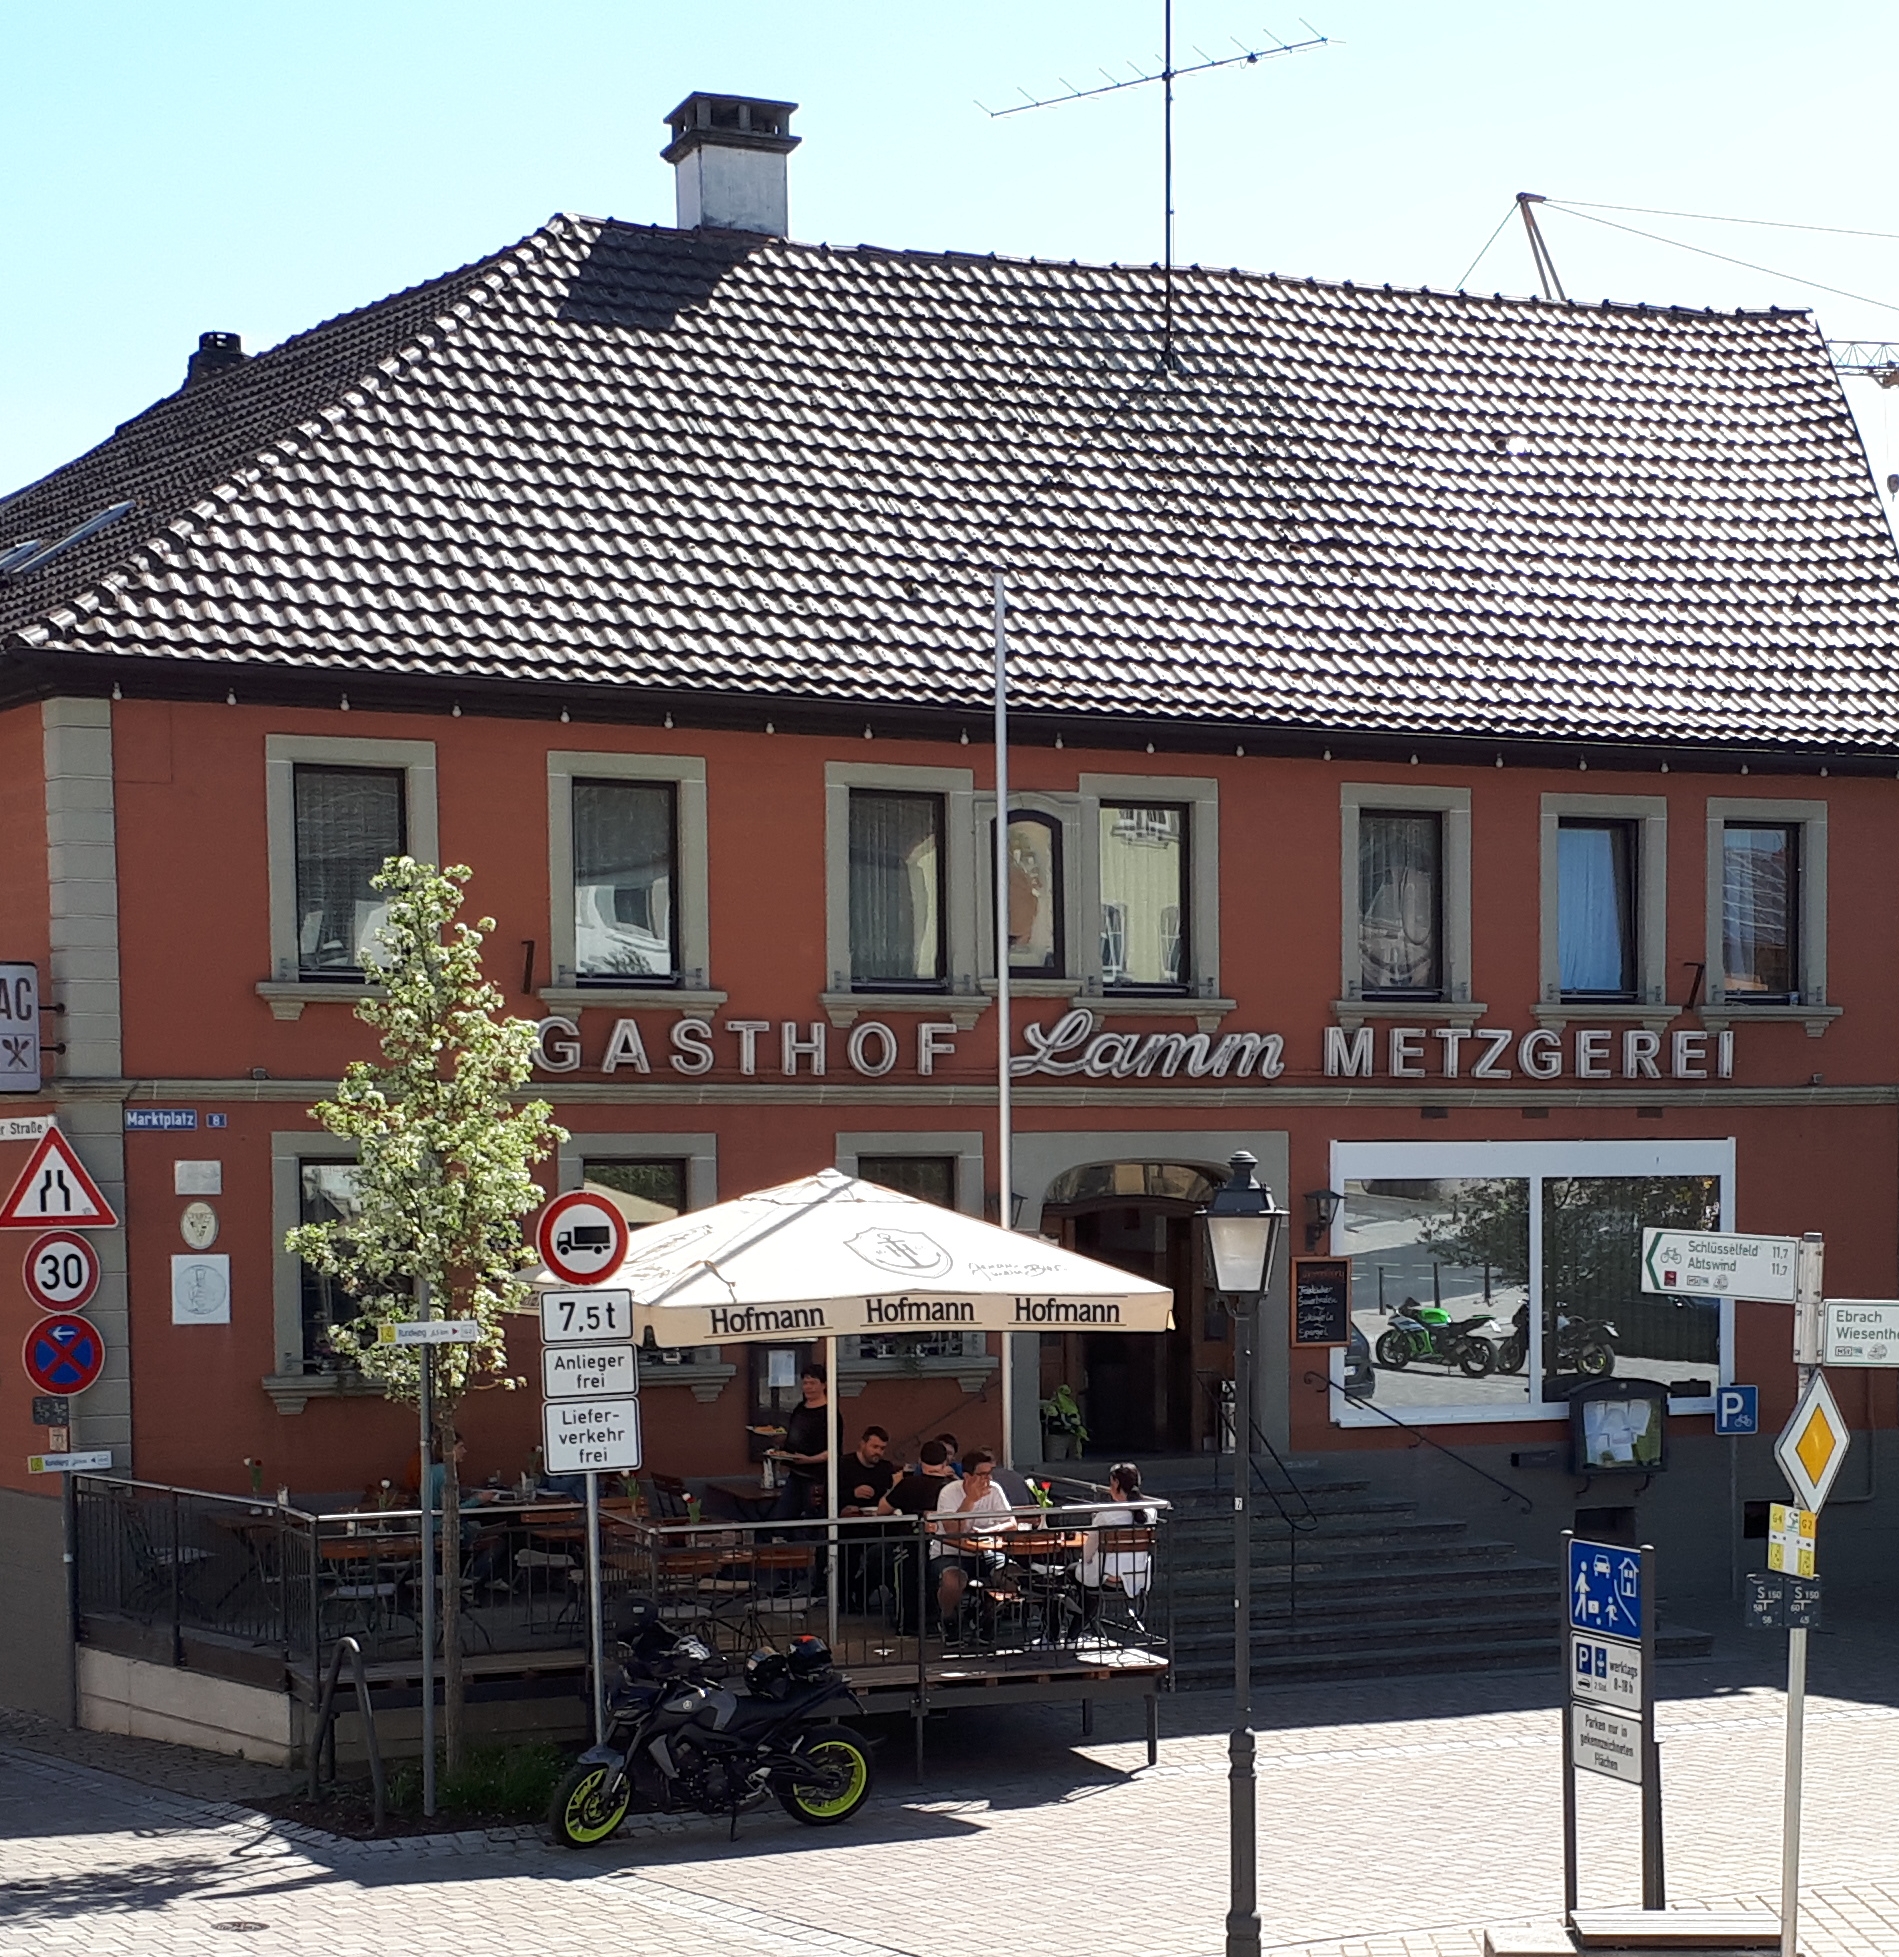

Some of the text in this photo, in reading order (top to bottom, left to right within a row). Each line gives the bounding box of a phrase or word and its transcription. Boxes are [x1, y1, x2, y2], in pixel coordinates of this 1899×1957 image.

[531, 1006, 1735, 1080] GASTHOF Lamm METZGEREI
[10, 1121, 43, 1135] Straße
[127, 1112, 195, 1129] Marktplatz
[213, 1116, 220, 1126] 8
[1688, 1240, 1789, 1259] Schlüsselfeld 11,7
[41, 1254, 82, 1291] 30
[1688, 1257, 1737, 1272] Abtswind
[711, 1298, 1120, 1334] Hofmann Hofmann Hofmann
[1836, 1310, 1882, 1323] Ebrach
[554, 1355, 625, 1372] Anlieger
[577, 1373, 605, 1389] frei
[562, 1410, 620, 1426] Liefer-
[1721, 1392, 1743, 1428] P
[558, 1428, 625, 1444] verkehr
[579, 1448, 608, 1464] frei
[1802, 1519, 1813, 1530] G2
[1757, 1586, 1765, 1599] S
[1794, 1586, 1802, 1599] S
[1580, 1646, 1589, 1670] P
[1609, 1661, 1638, 1680] werktags
[1585, 1714, 1628, 1738] Parken nur in
[1580, 1734, 1634, 1757] gekennzeichneten
[1594, 1752, 1618, 1771] Flächen
